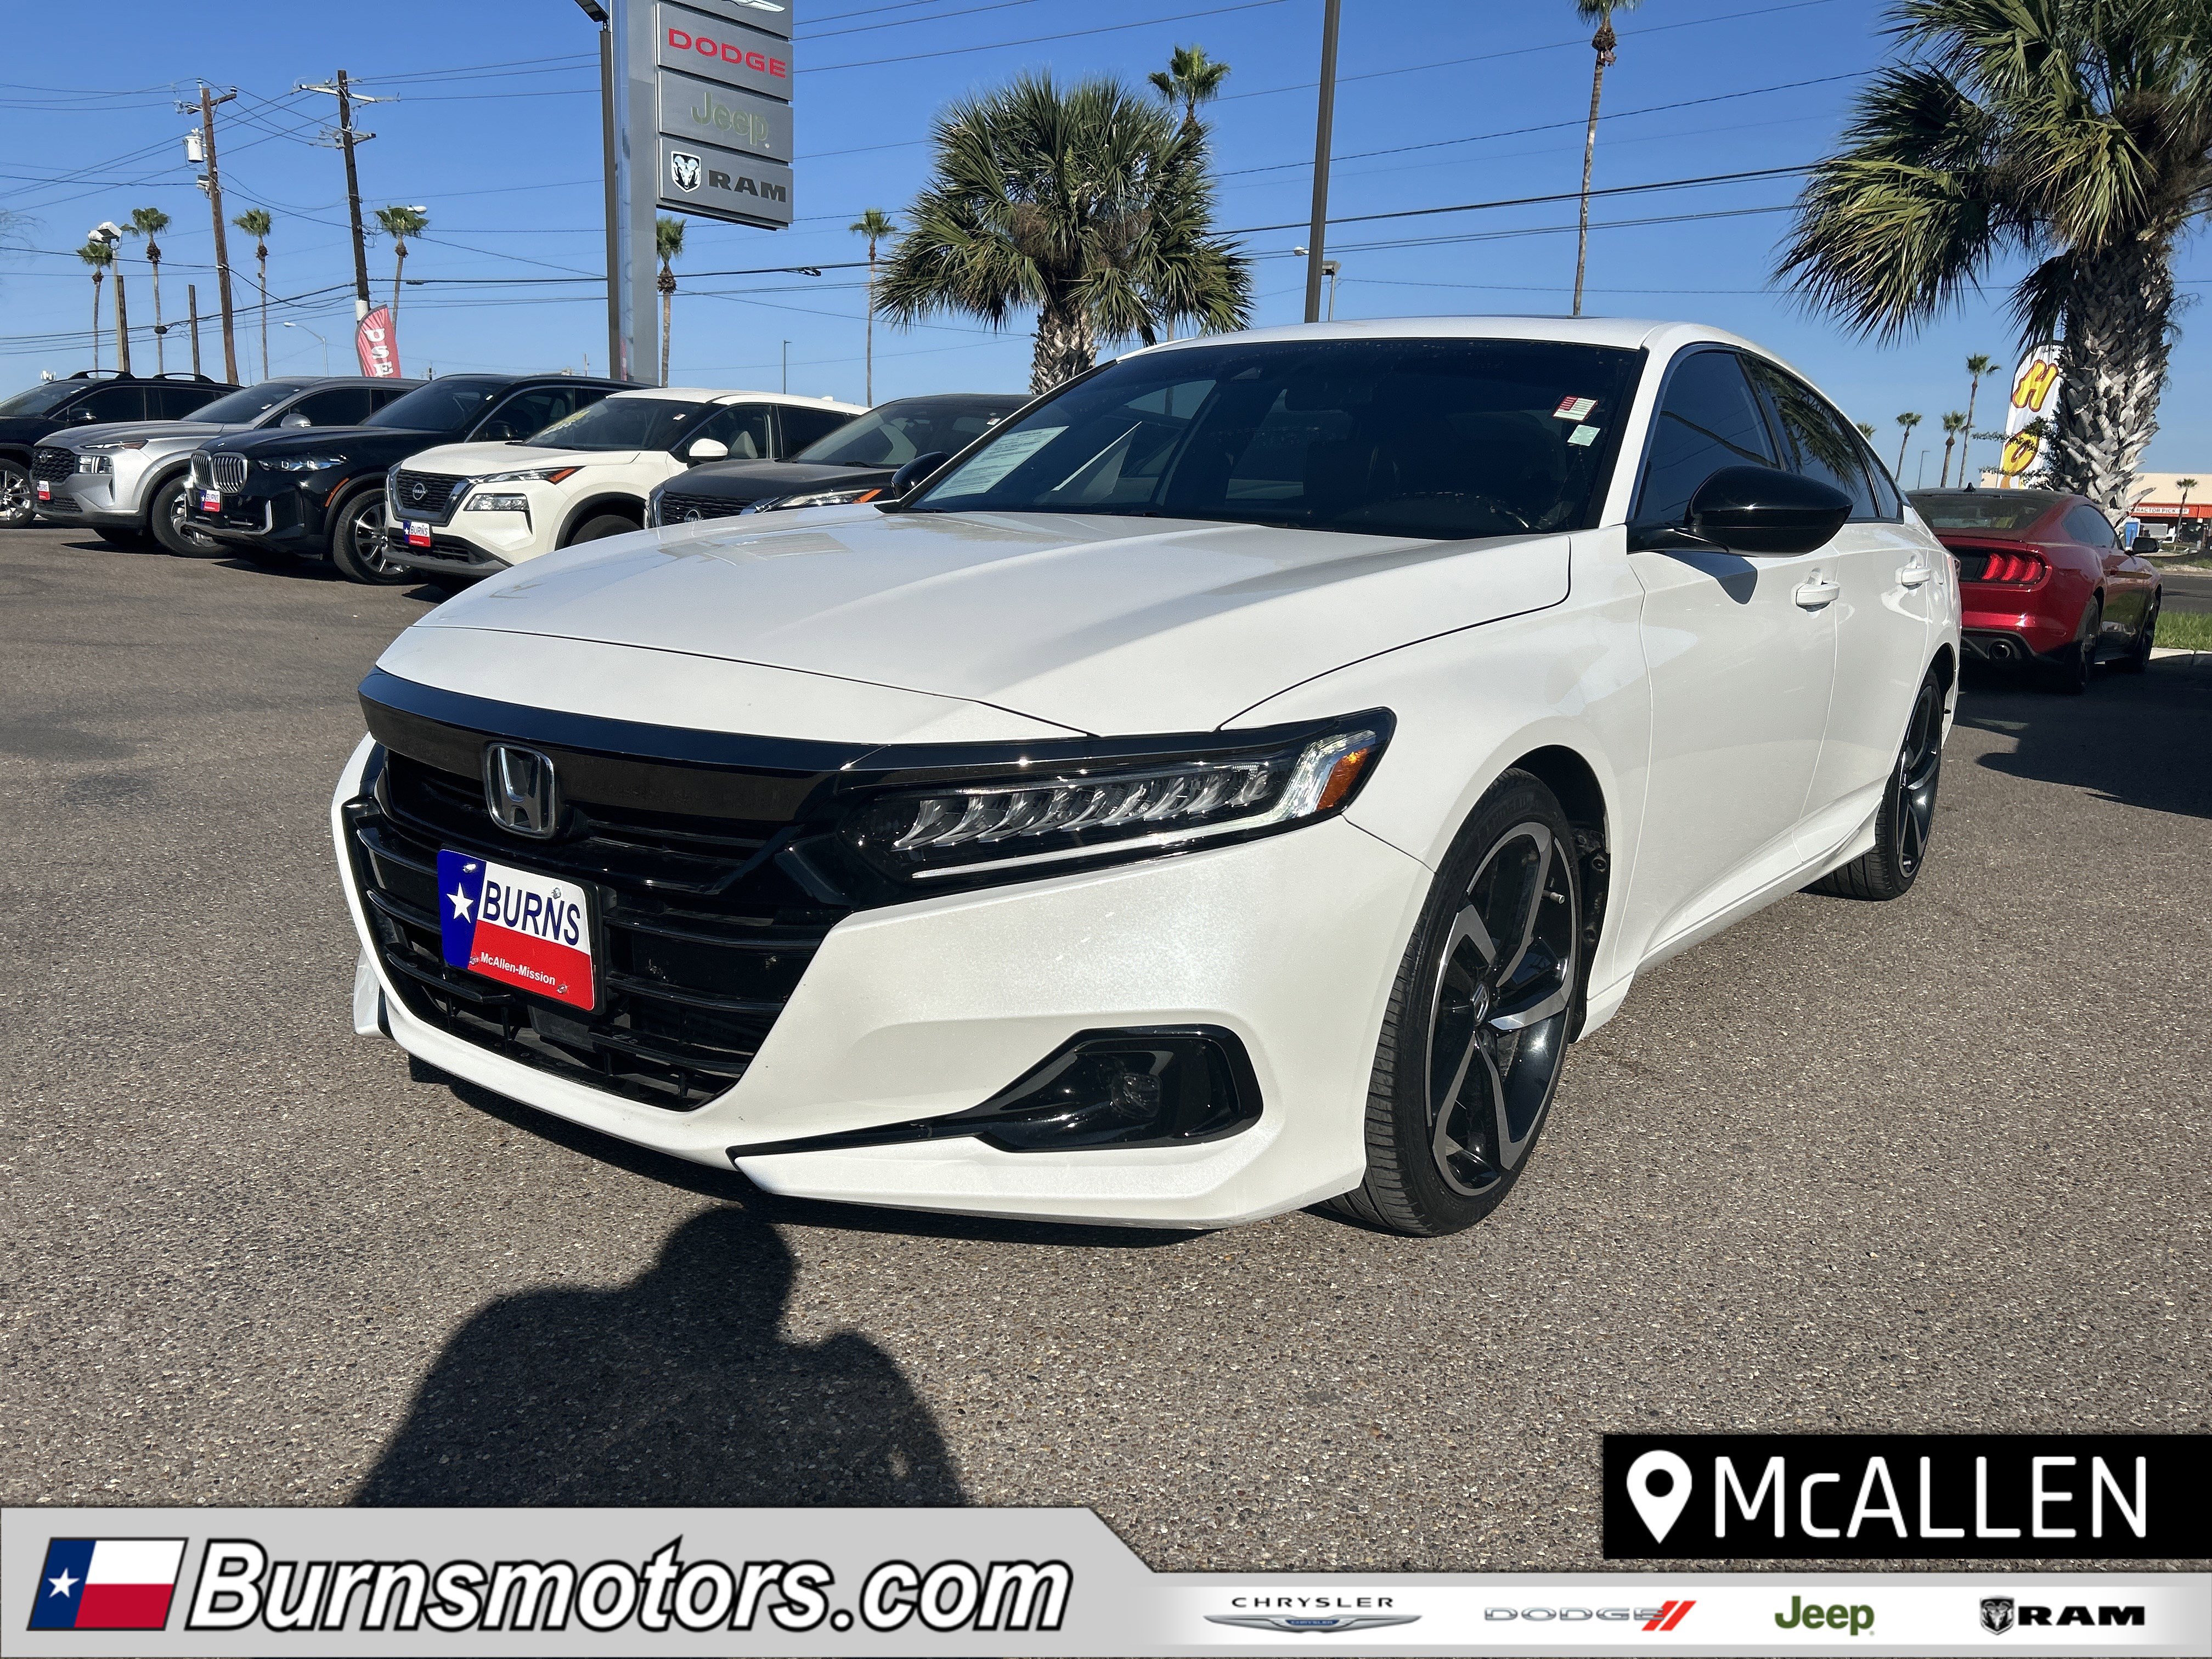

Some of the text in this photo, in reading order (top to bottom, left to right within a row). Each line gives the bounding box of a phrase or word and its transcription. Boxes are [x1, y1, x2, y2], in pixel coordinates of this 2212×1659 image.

[668, 28, 786, 78] DODGE
[691, 92, 768, 146] Jeep
[708, 170, 786, 202] RAM
[410, 526, 428, 536] BURNS
[482, 879, 581, 946] BURNS
[480, 951, 556, 986] McAllen-Mission
